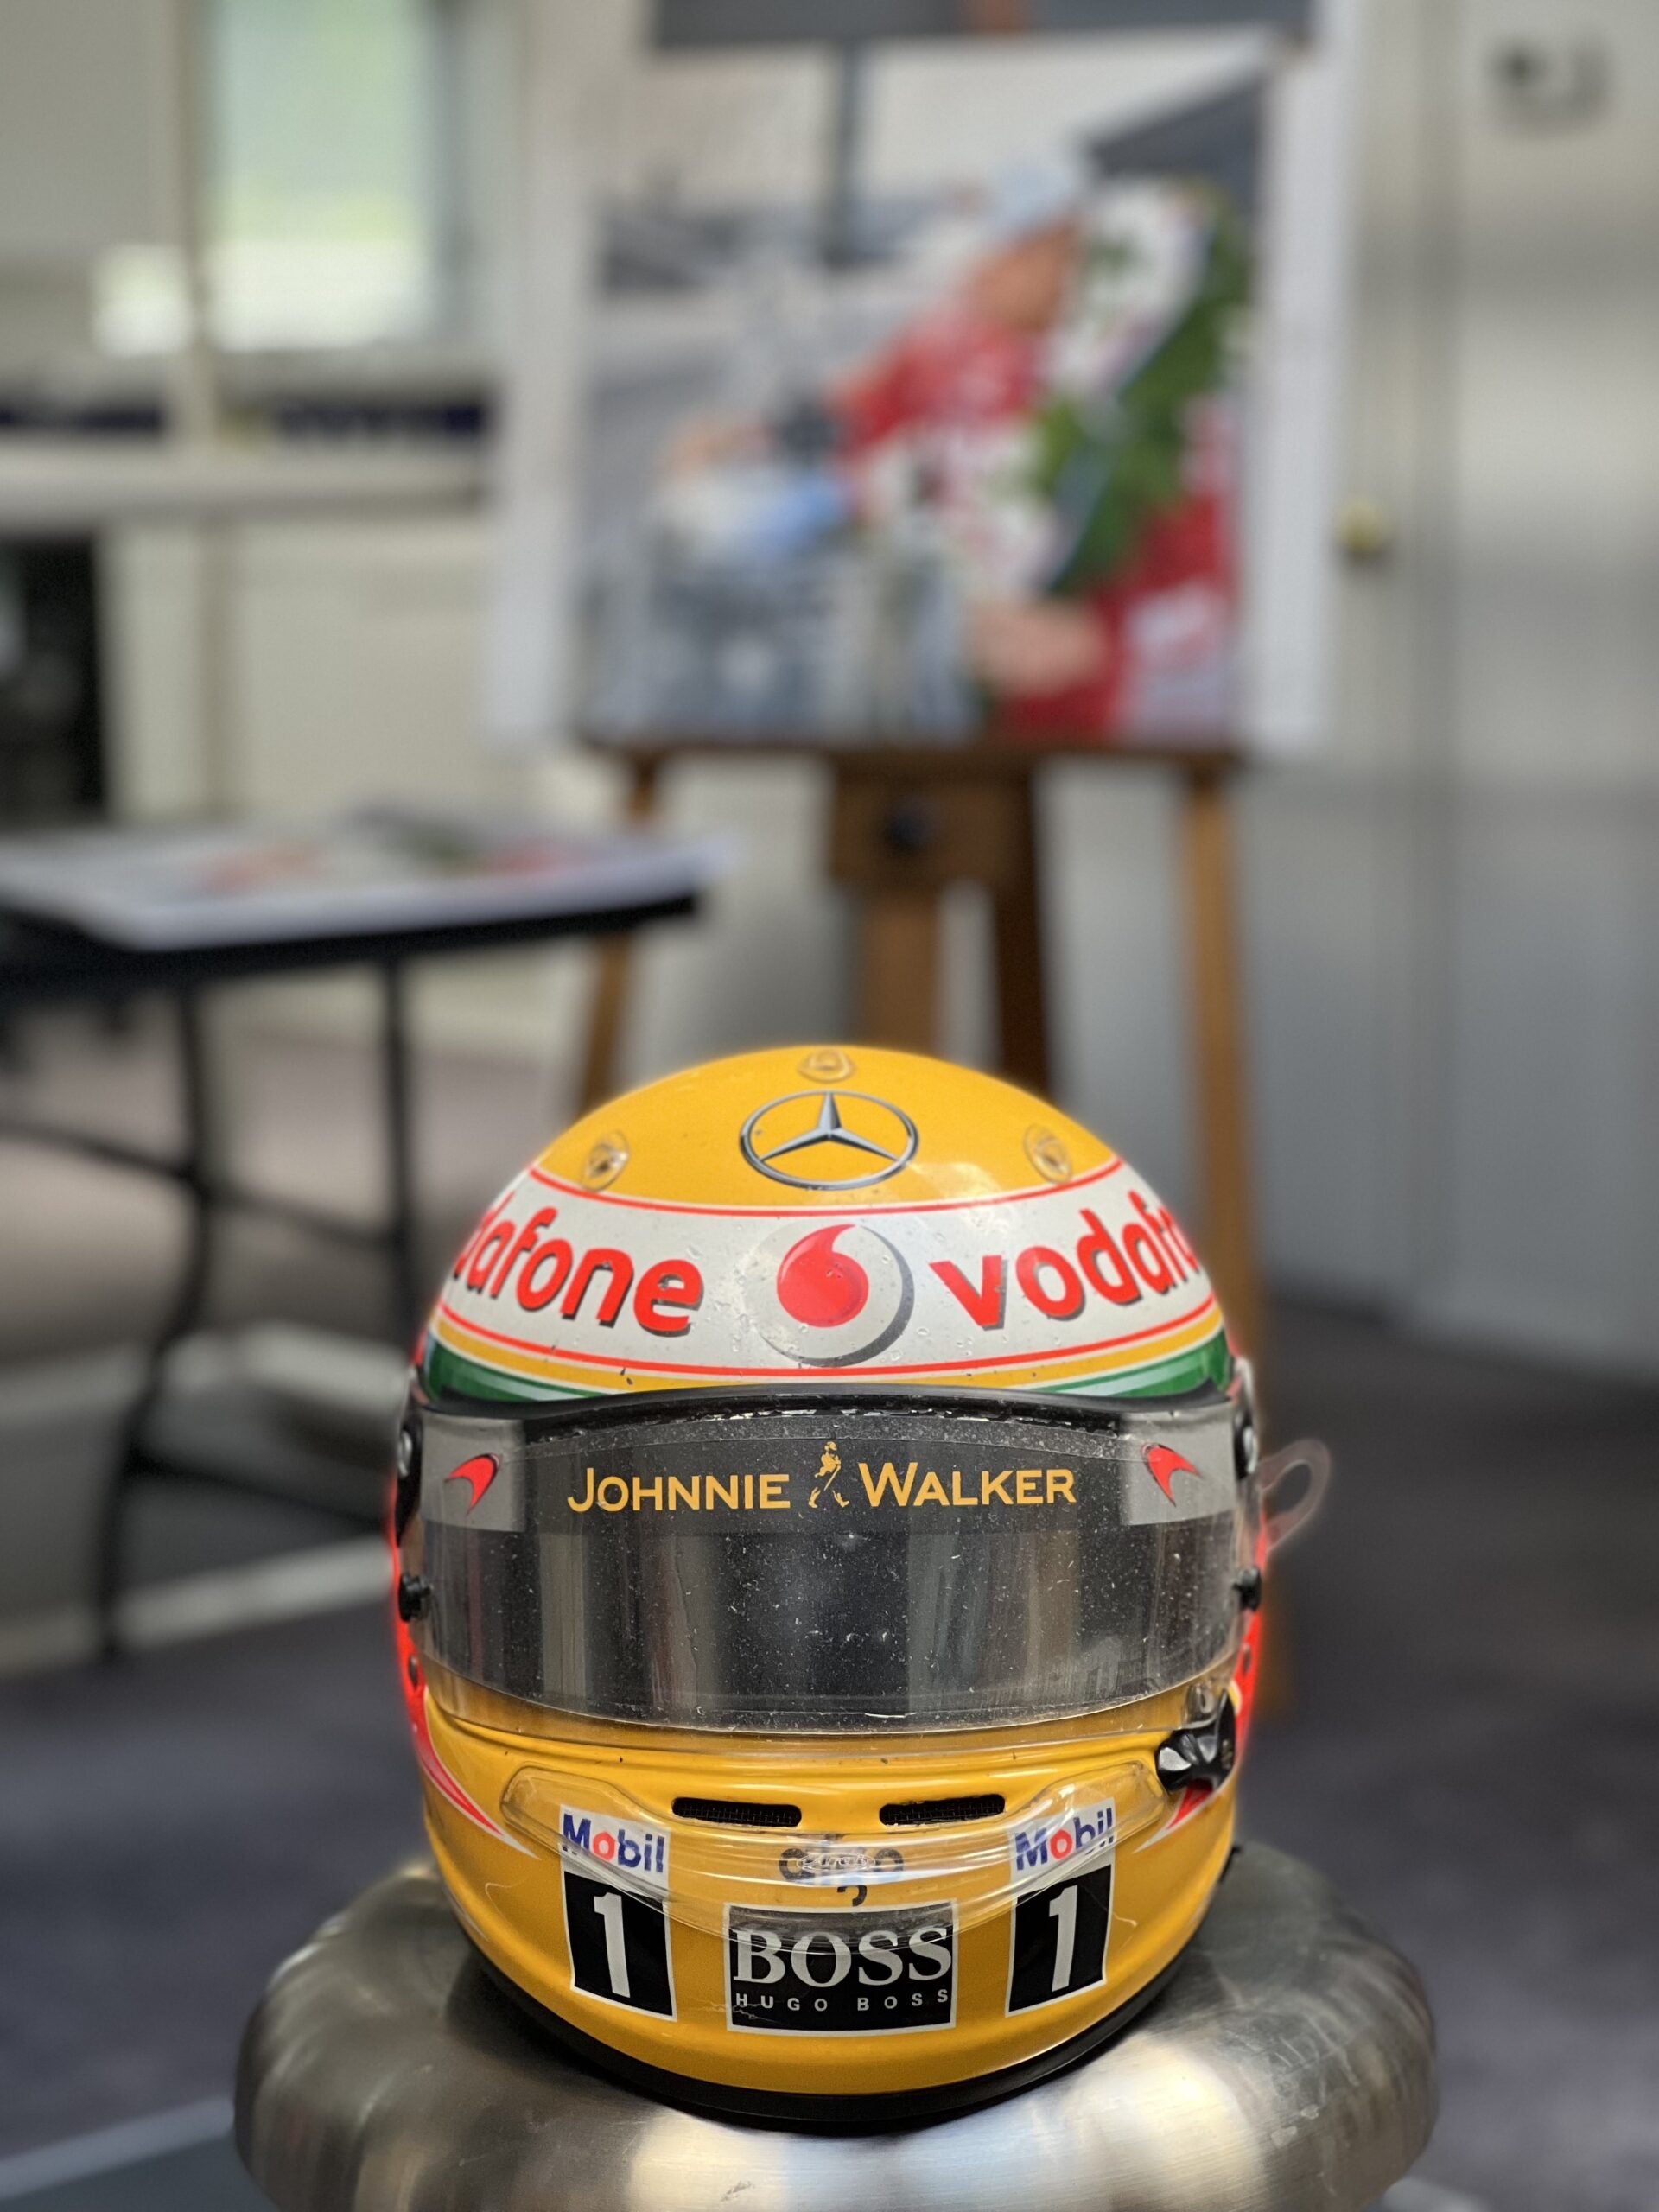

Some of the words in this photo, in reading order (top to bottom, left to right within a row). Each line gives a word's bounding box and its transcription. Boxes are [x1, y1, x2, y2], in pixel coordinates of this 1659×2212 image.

[567, 1467, 791, 1512] JOHNNIE
[858, 1462, 1077, 1507] WALKER
[563, 1813, 665, 1873] Mobil
[1014, 1807, 1114, 1871] Mobil
[593, 1891, 631, 1999] 1
[733, 1926, 952, 1988] BOSS
[1048, 1884, 1078, 1993] 1
[735, 1992, 829, 2012] HUGO
[856, 1988, 949, 2012] BOSS
